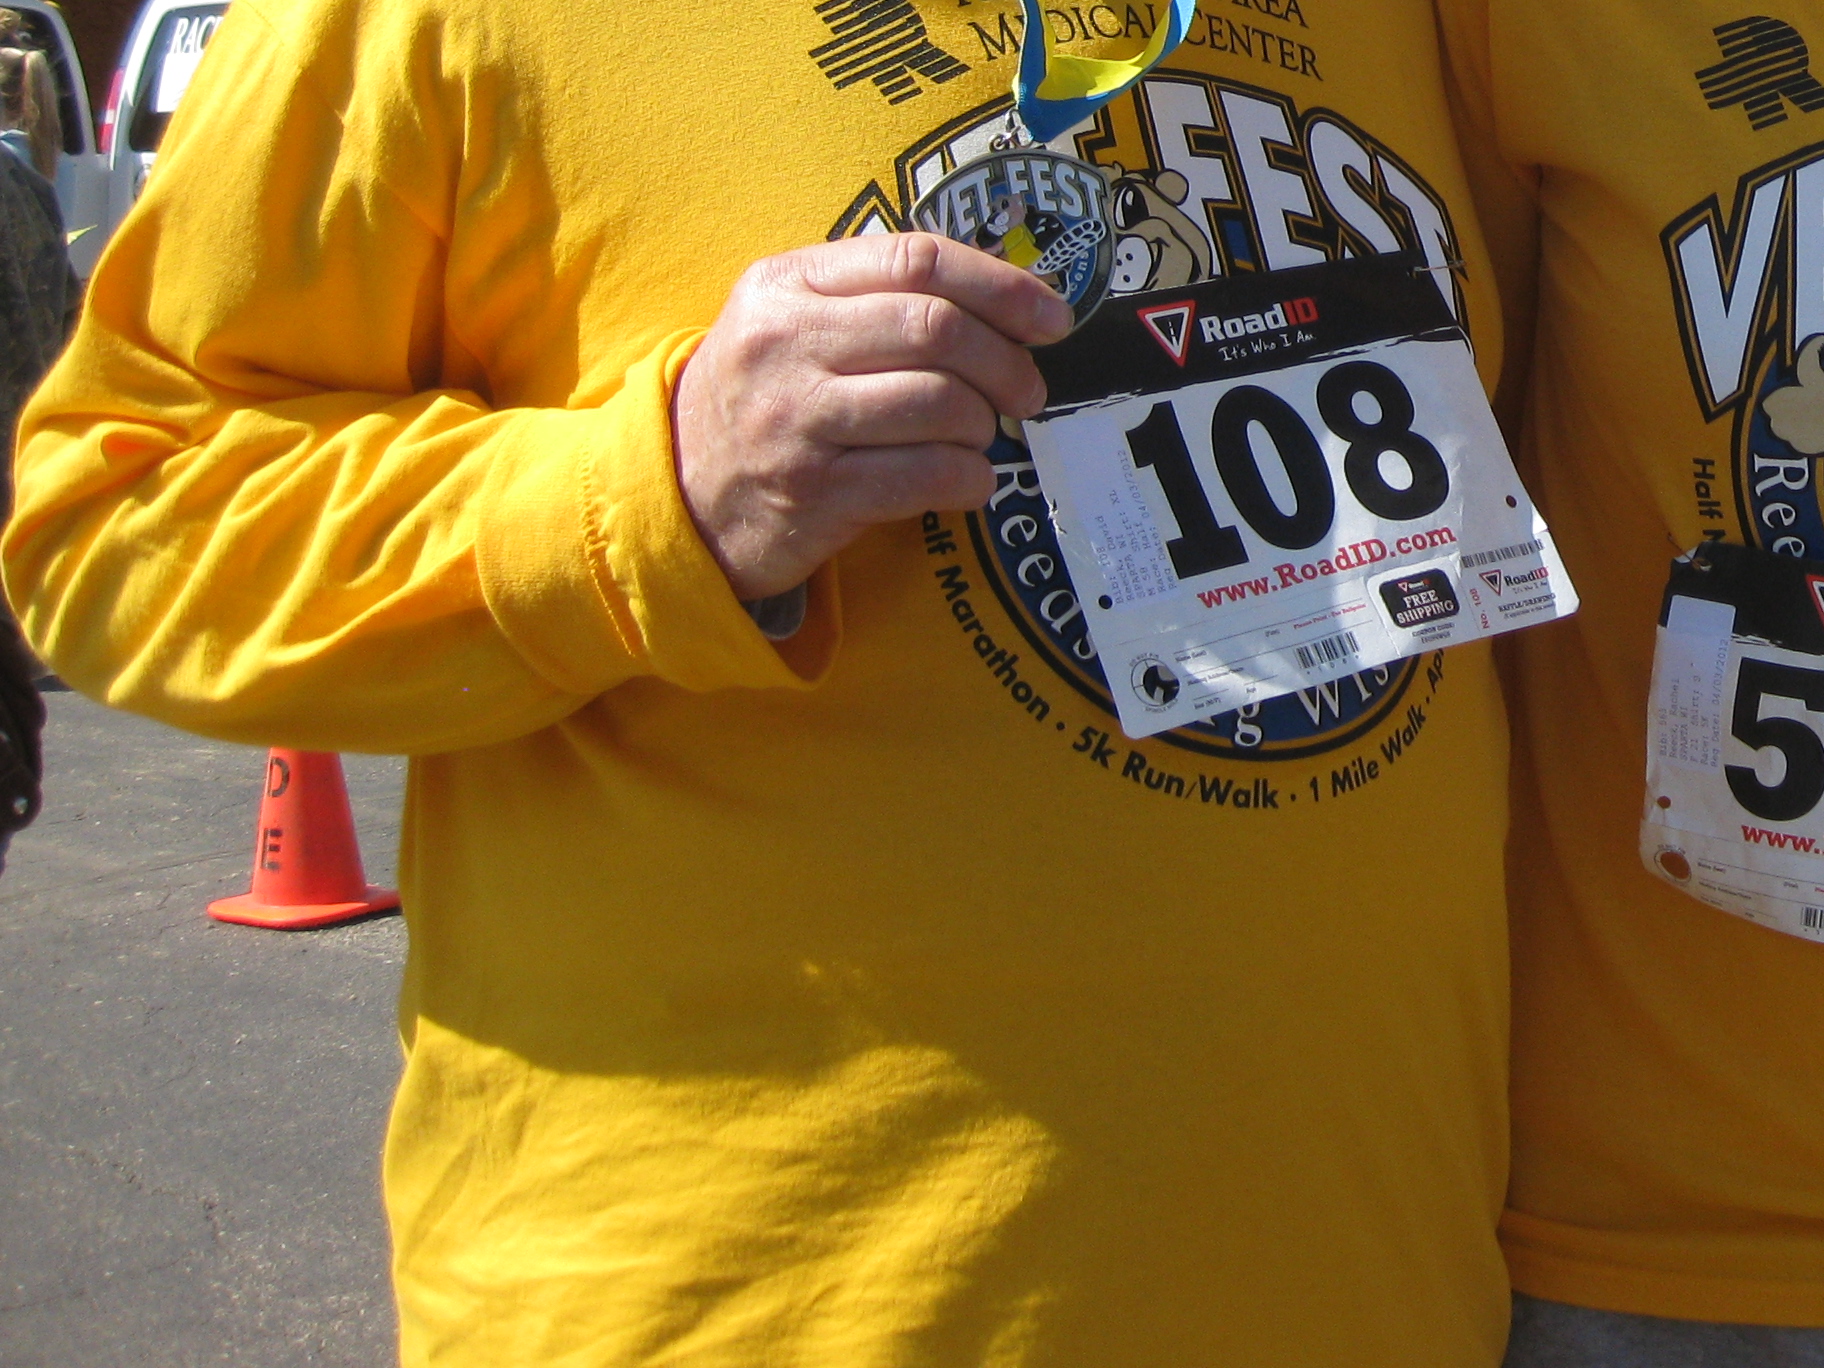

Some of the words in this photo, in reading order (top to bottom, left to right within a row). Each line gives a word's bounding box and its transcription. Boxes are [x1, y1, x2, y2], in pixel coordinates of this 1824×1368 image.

[920, 166, 995, 237] VET
[1005, 158, 1108, 222] FEST
[1199, 297, 1319, 343] RoadID
[1218, 345, 1247, 361] It's
[1250, 338, 1276, 353] Who
[1280, 334, 1291, 347] I
[1125, 359, 1450, 580] 108
[1693, 457, 1724, 519] Half
[921, 510, 957, 555] alf
[1196, 523, 1457, 610] www.RoadID.com
[1504, 566, 1548, 587] RoadID
[1396, 599, 1454, 625] SHIPPING
[1402, 589, 1439, 609] FREE
[934, 563, 1050, 722] Marathon
[1713, 639, 1728, 705] 04/03/2012
[1071, 725, 1116, 771] 5k
[1379, 704, 1428, 765] Walk
[1121, 749, 1280, 809] Run/Walk
[1331, 756, 1380, 798] Mile
